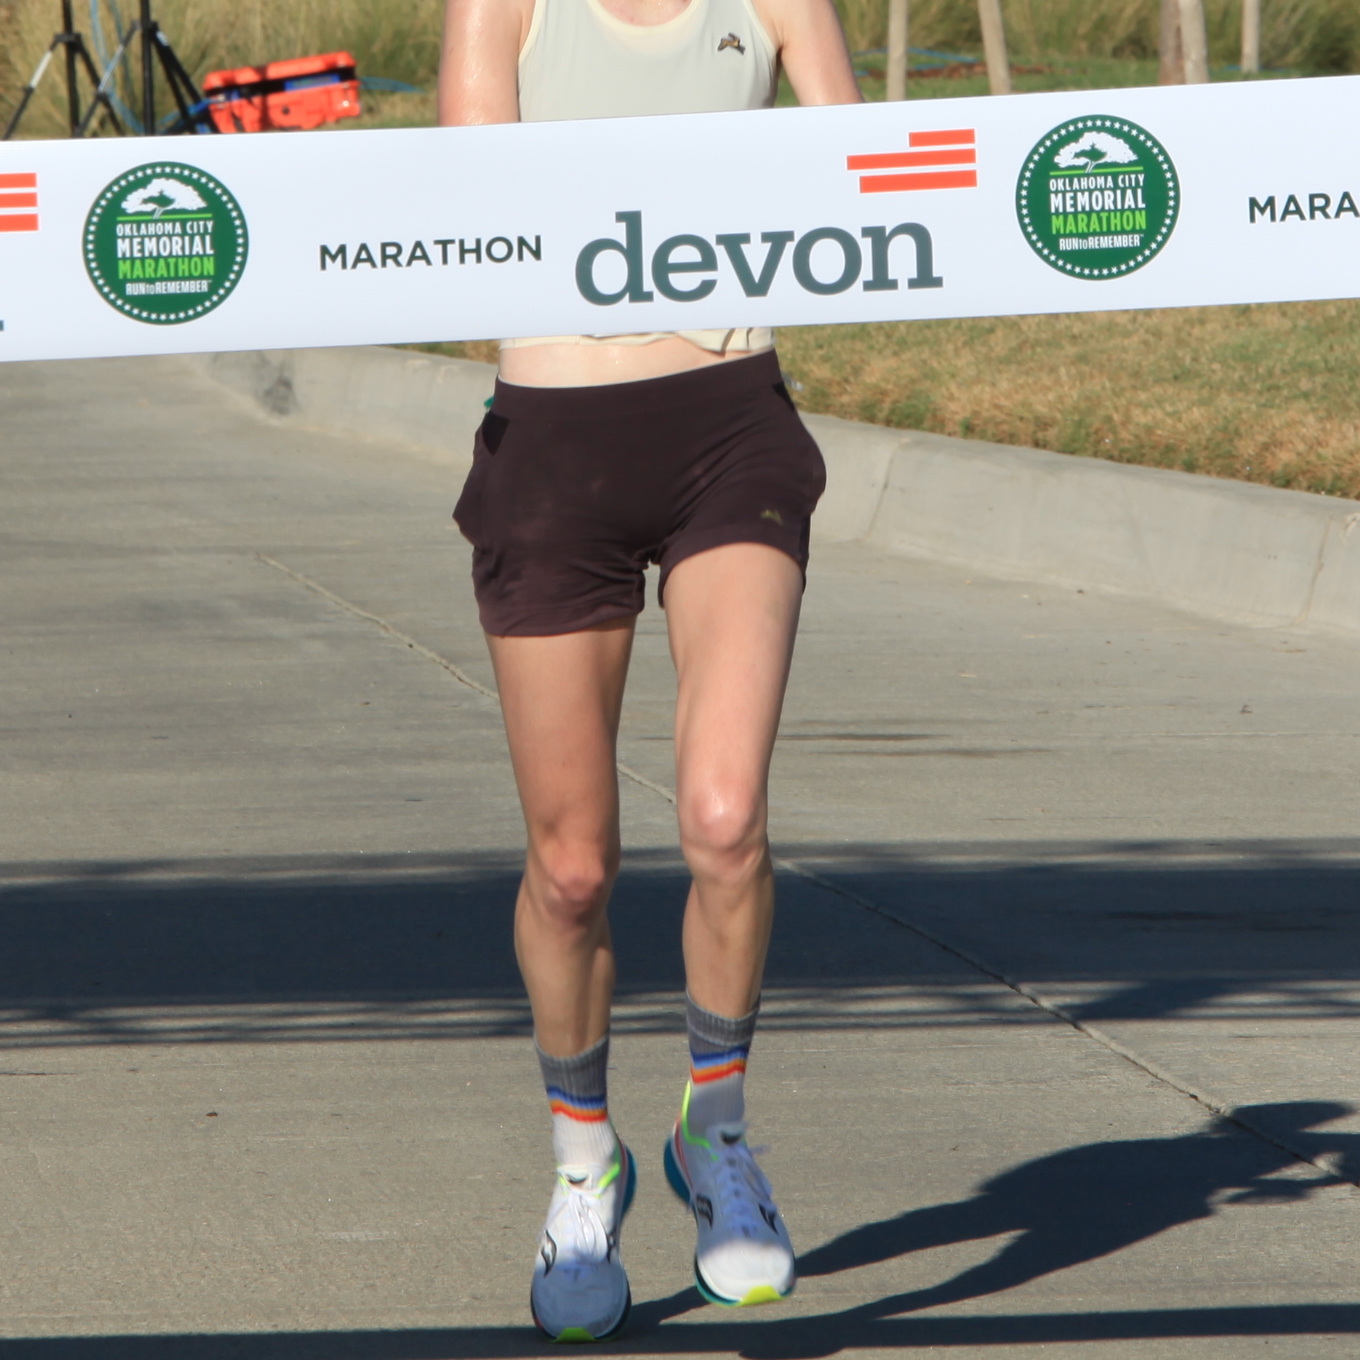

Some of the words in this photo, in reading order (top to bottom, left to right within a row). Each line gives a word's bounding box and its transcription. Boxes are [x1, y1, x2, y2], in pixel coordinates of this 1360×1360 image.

[1049, 175, 1114, 191] OKLAHOMA
[1118, 174, 1145, 188] CITY
[1050, 188, 1146, 213] MEMORIAL
[116, 222, 182, 237] OKLAHOMA
[186, 220, 214, 234] CITY
[1051, 210, 1147, 235] MARATHON
[116, 234, 215, 258] MEMORIAL
[319, 234, 542, 271] MARATHON
[118, 256, 215, 280] MARATHON
[574, 210, 944, 307] devon
